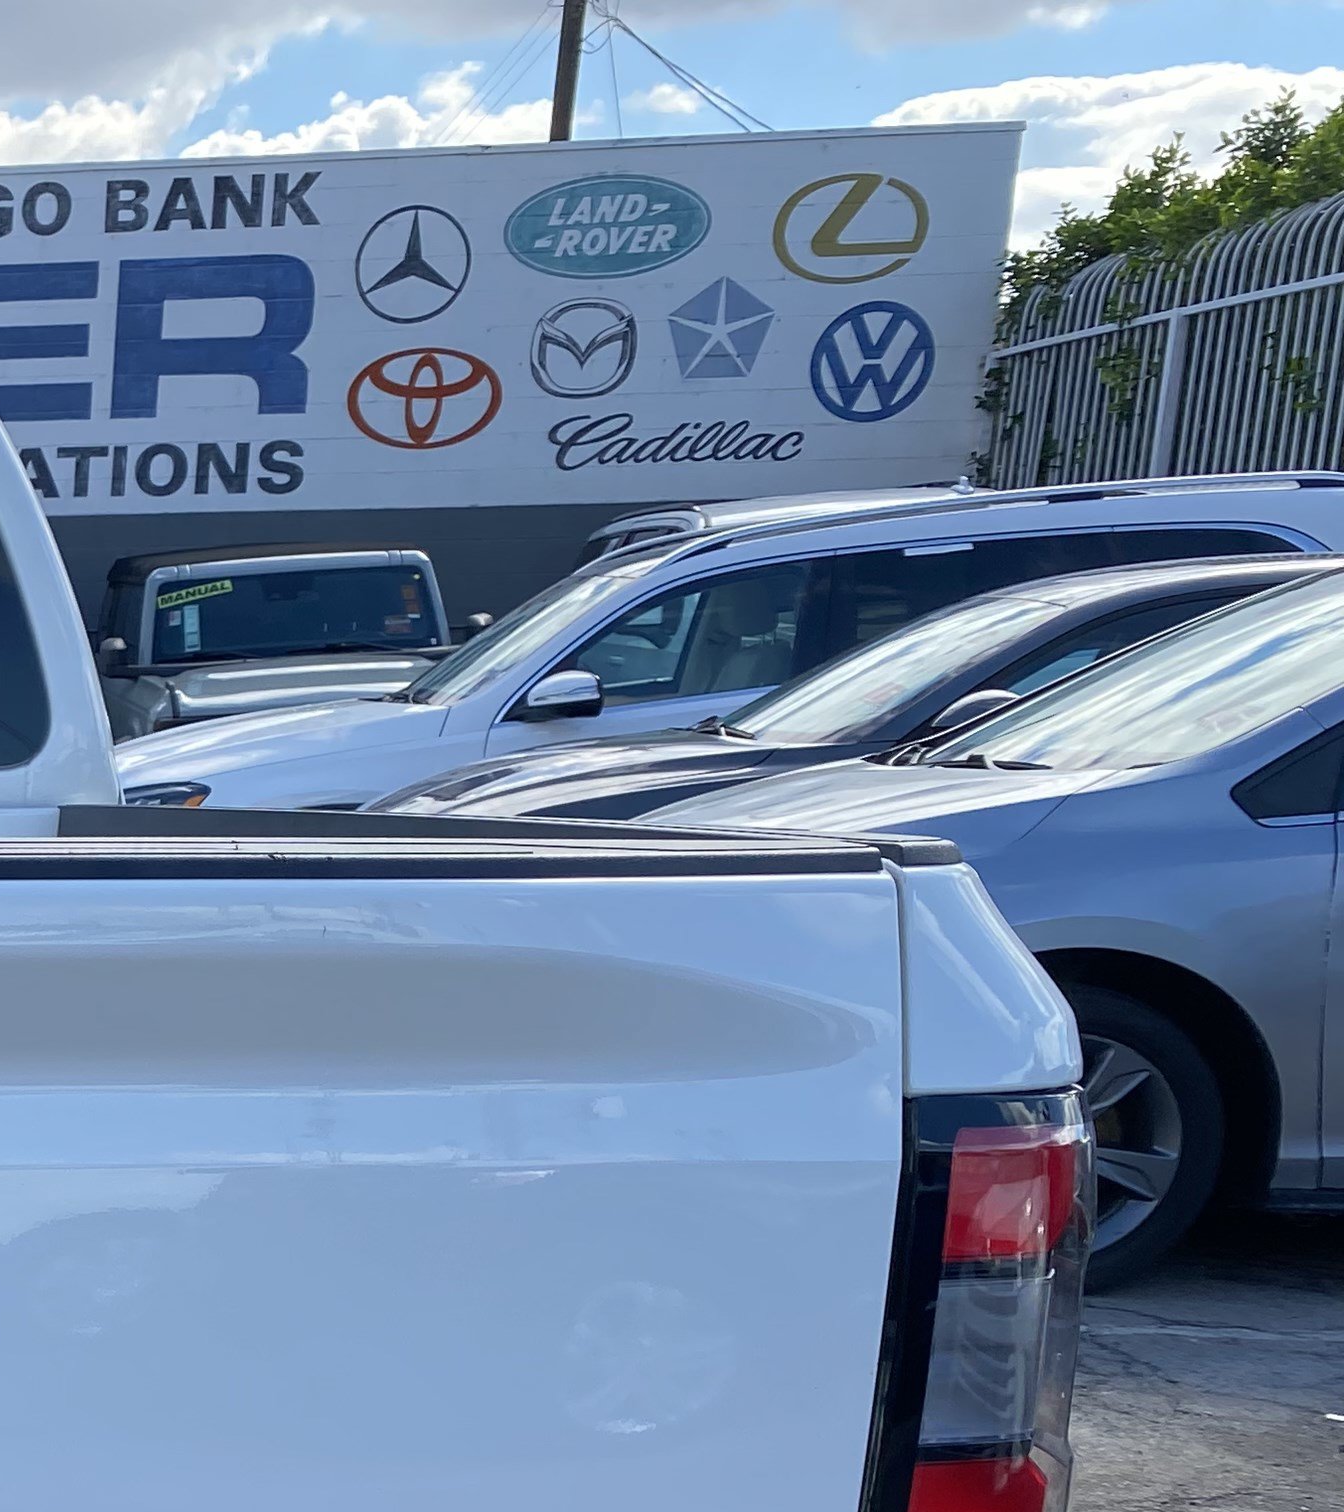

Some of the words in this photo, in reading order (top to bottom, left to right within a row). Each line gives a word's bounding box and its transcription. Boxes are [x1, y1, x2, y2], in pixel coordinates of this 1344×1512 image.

[105, 170, 322, 233] BANK
[548, 413, 804, 471] Cadillac
[160, 583, 230, 606] MANUAL
